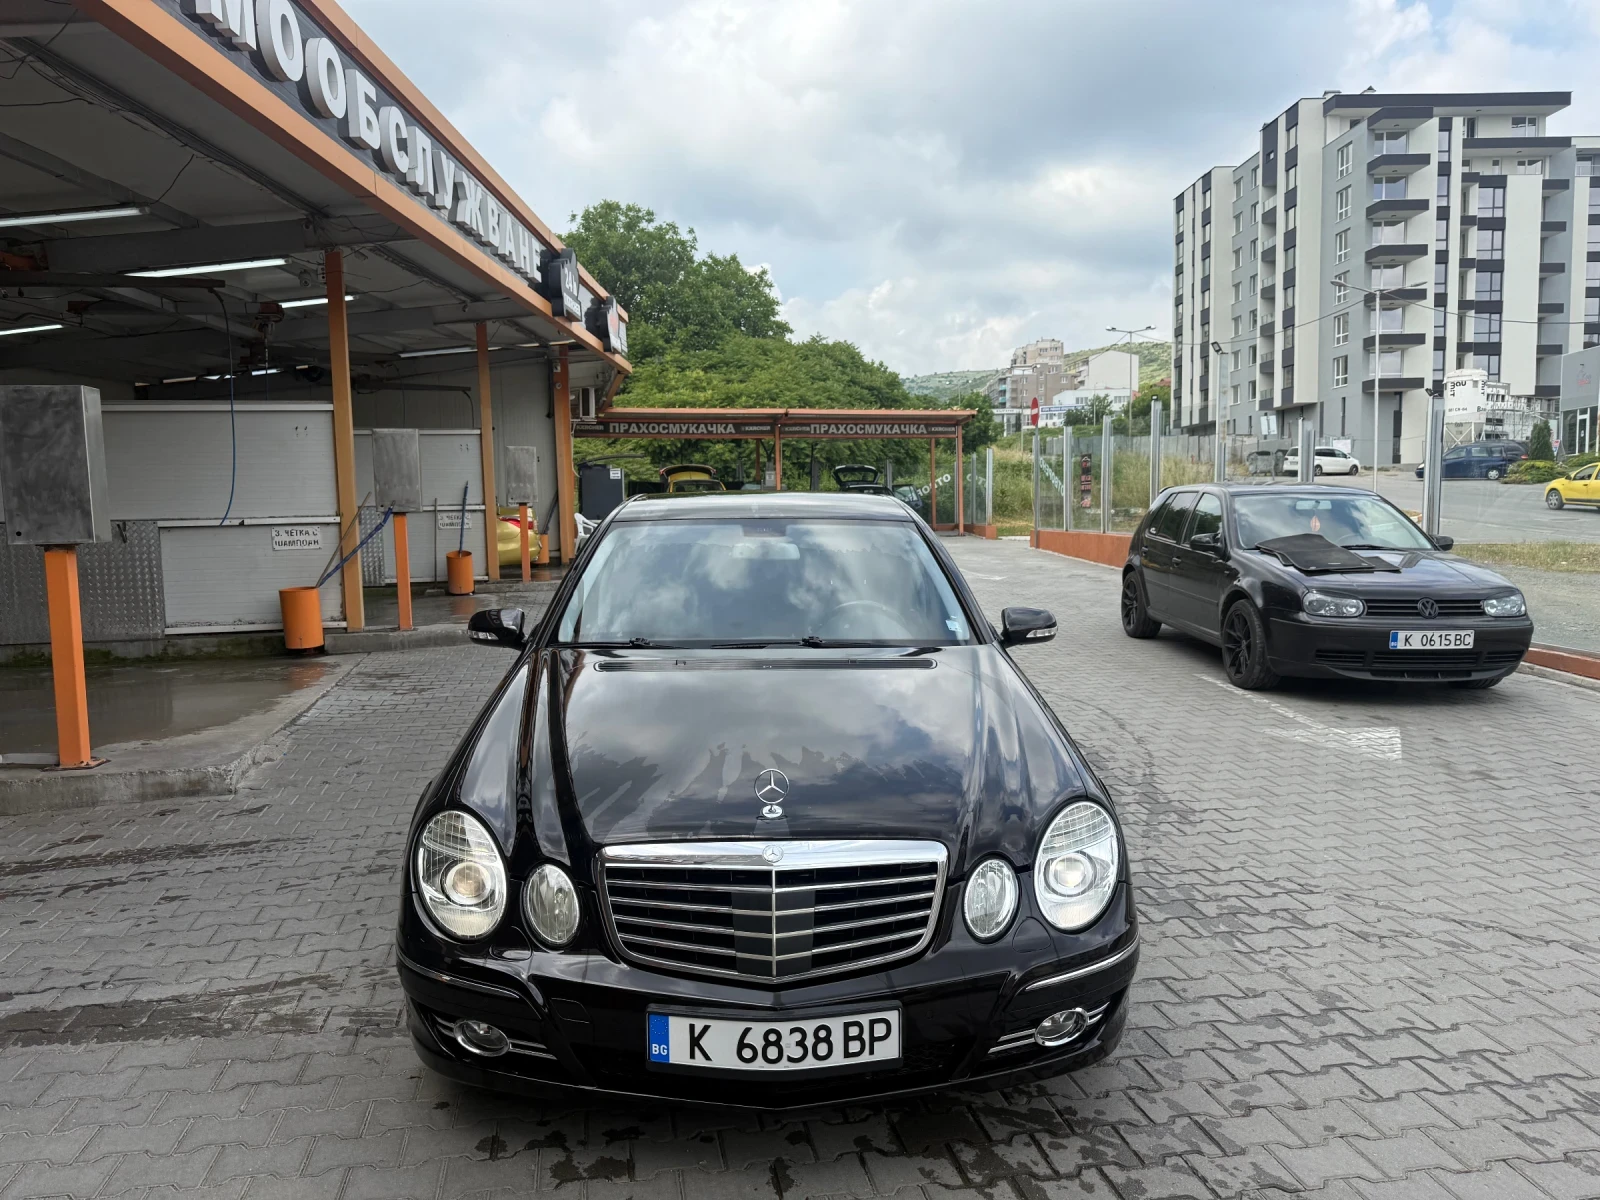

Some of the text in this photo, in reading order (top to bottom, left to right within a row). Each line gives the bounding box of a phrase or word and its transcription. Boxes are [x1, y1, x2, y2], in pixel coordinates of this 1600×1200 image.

[609, 423, 736, 435] ПРАХОСМУКАЧКА
[810, 424, 928, 435] ПРАХОСМУКАЧКА
[688, 1023, 713, 1061] K
[652, 1043, 668, 1055] BG
